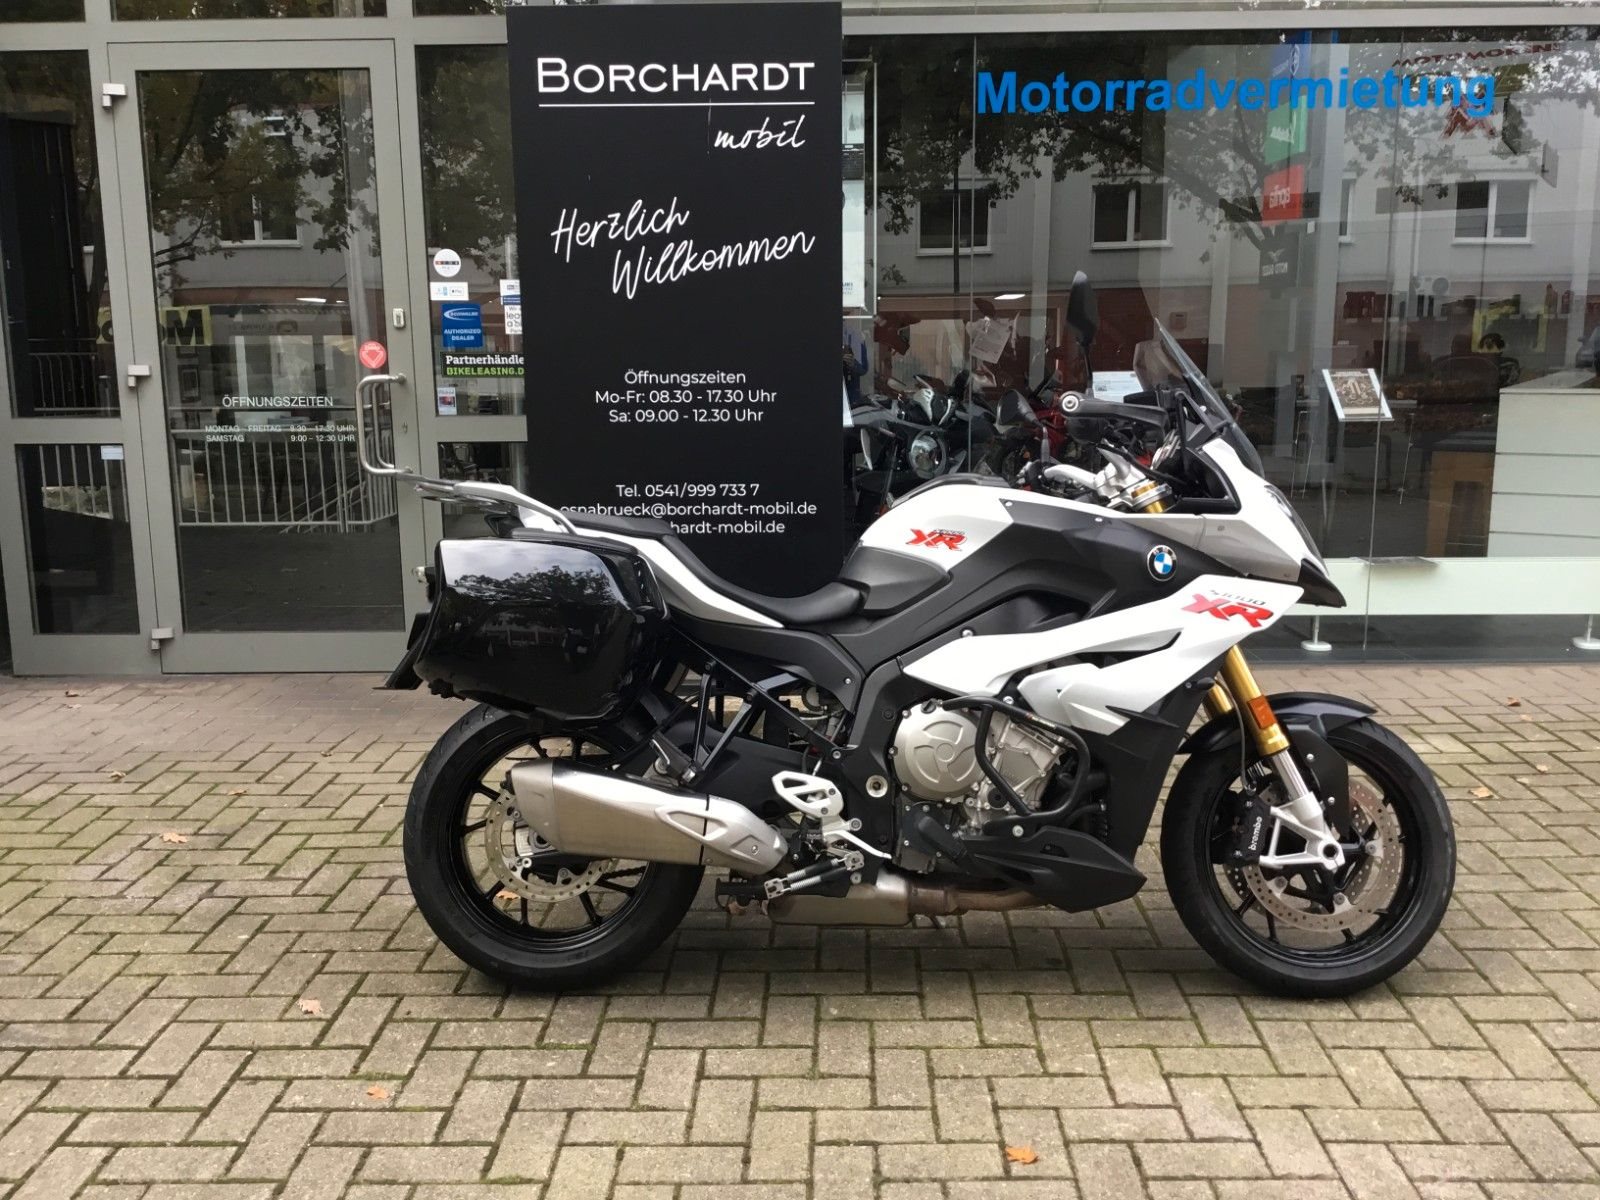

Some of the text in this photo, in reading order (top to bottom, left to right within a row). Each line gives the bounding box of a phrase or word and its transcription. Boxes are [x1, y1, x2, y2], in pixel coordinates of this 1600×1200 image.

[536, 57, 815, 93] BORCHARDT
[978, 68, 1495, 118] Motorradvermietung
[713, 114, 806, 149] mobil
[550, 196, 691, 264] Herzlich
[612, 231, 816, 300] Willkommen
[624, 368, 747, 387] Öffnungszeiten
[221, 394, 334, 408] ÖFFNUNGSZEITEN
[595, 390, 646, 404] Mo-Fr:
[649, 390, 693, 404] 08.30
[706, 389, 744, 403] 17.30
[748, 389, 778, 403] Uhr
[608, 409, 632, 423] Sa:
[635, 409, 679, 423] 09.00
[692, 409, 731, 422] 12.30
[735, 408, 764, 422] Uhr
[205, 424, 240, 433] MONTAG
[247, 424, 282, 433] FREITAG
[336, 424, 355, 433] UHR
[205, 434, 245, 443] SAMSTAG
[290, 434, 308, 442] 9:00
[315, 434, 336, 442] 12:30
[337, 434, 356, 442] UHR
[615, 482, 760, 499] Tel. 0541/999 733 7
[905, 528, 968, 551] XR
[1181, 593, 1274, 628] XR
[1247, 816, 1263, 851] brembo
